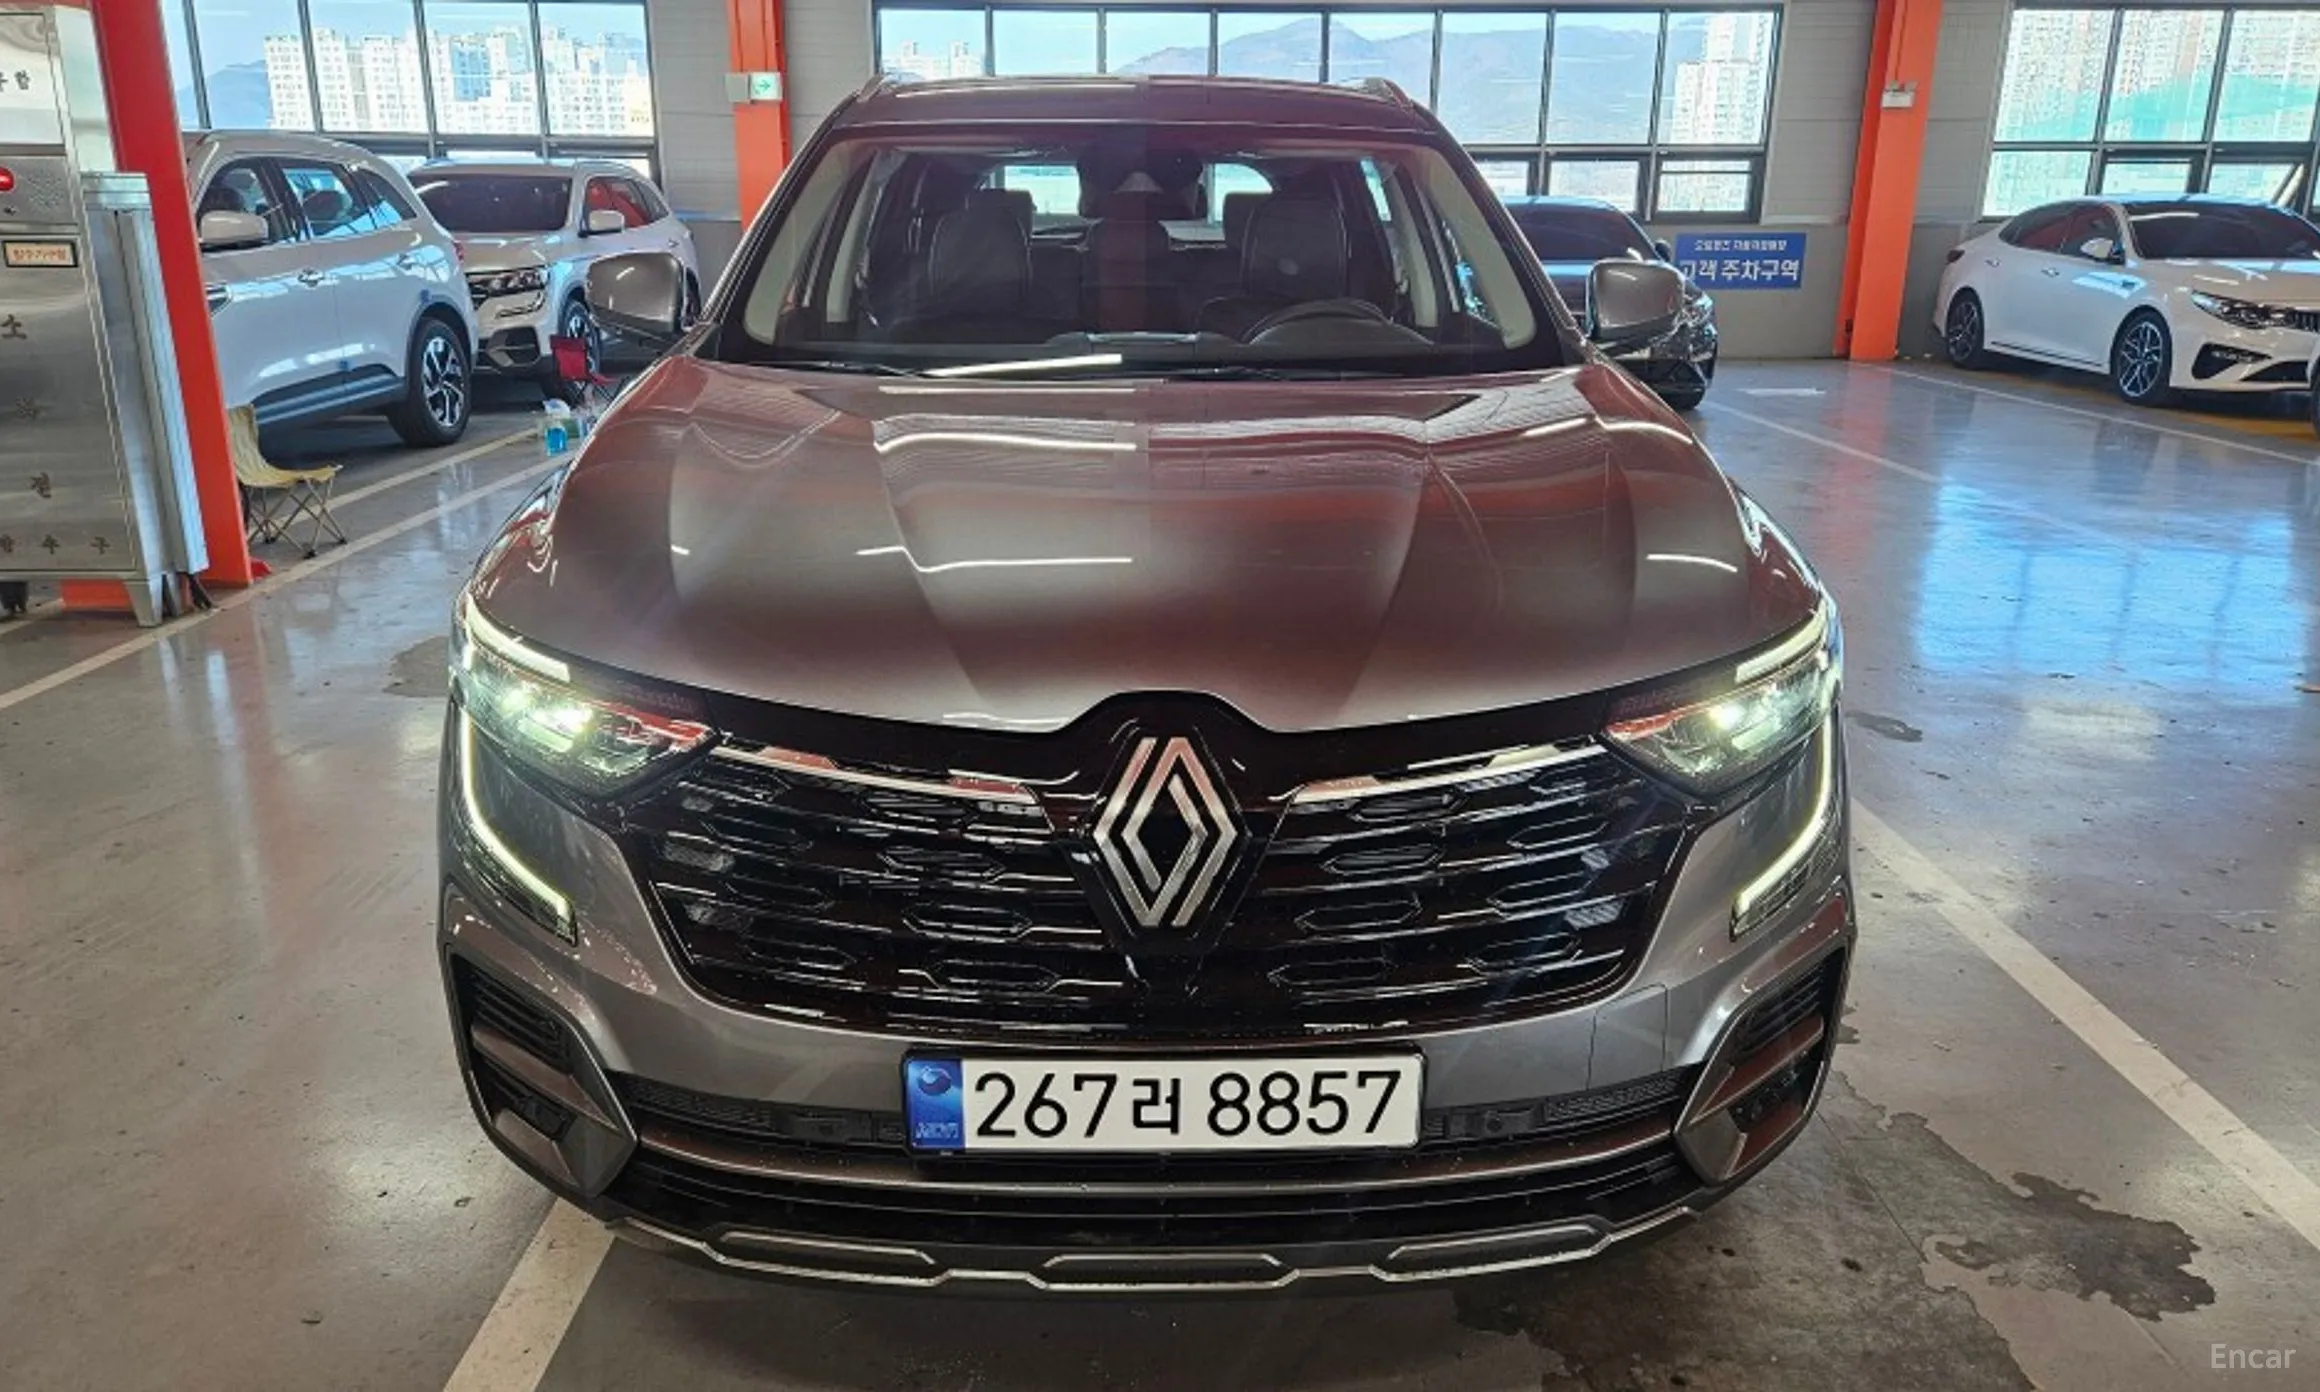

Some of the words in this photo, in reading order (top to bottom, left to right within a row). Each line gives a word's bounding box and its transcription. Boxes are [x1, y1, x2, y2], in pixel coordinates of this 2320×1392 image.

[1680, 259, 1718, 281] 고객
[1721, 259, 1800, 281] 주차구역
[1207, 1071, 1402, 1137] 8857
